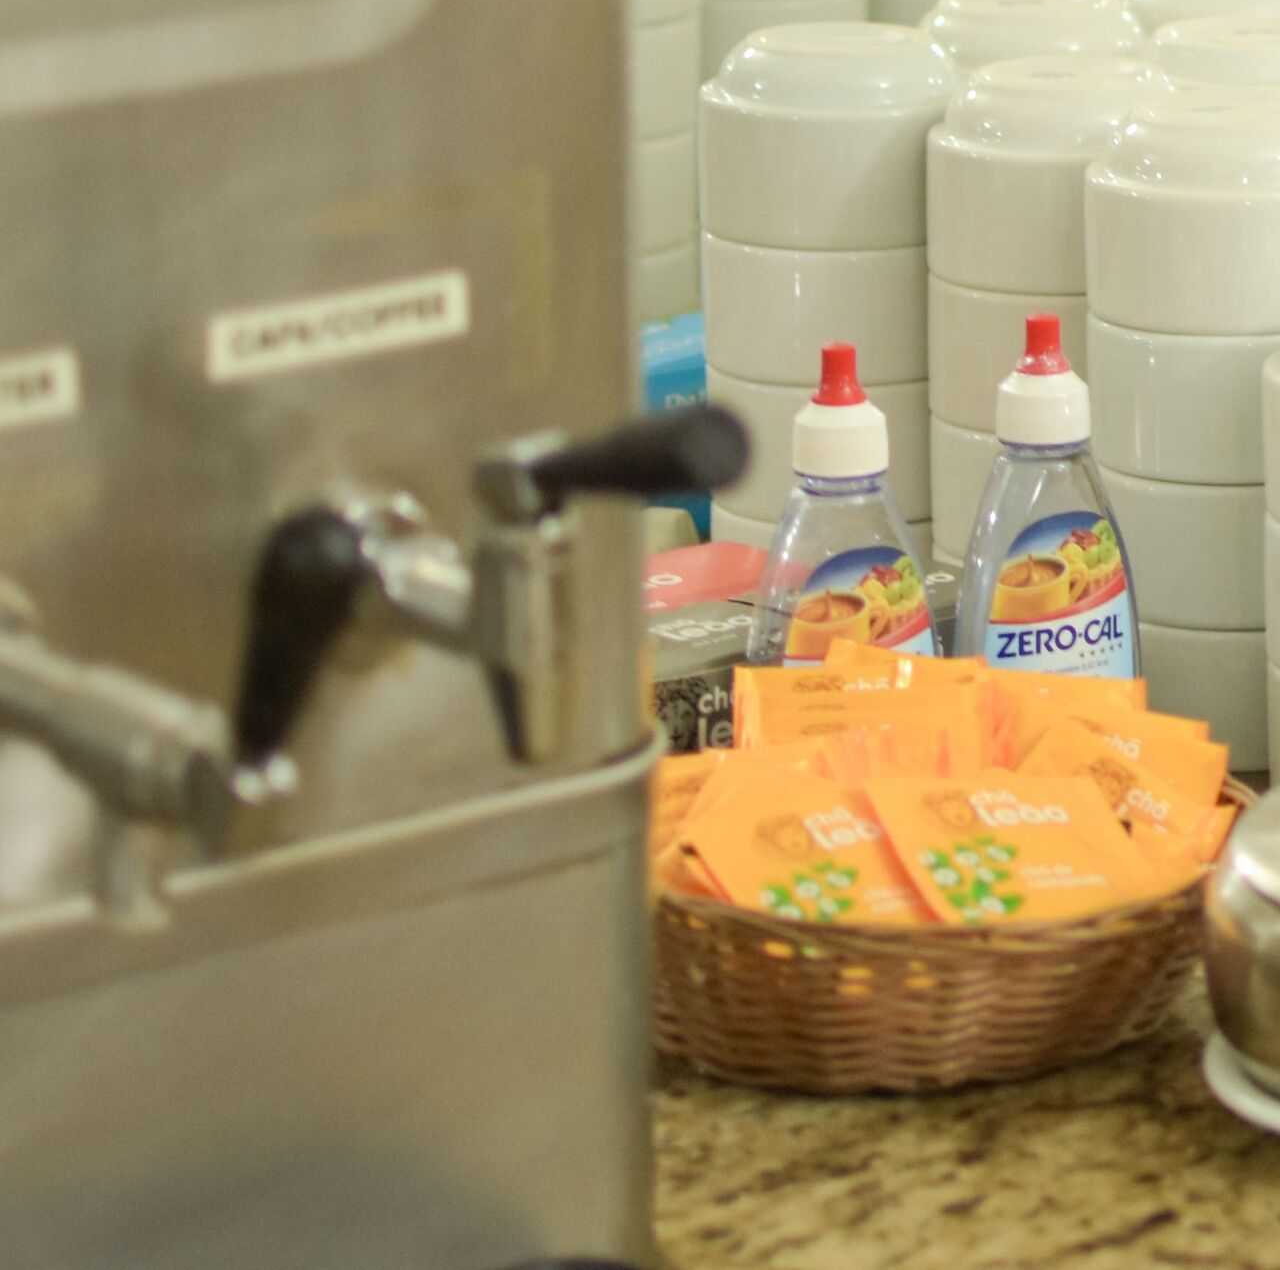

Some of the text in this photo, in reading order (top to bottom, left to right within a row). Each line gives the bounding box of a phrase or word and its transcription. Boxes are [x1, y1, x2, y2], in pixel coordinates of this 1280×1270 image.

[699, 686, 736, 714] ch
[697, 717, 734, 748] le
[808, 818, 882, 852] leã
